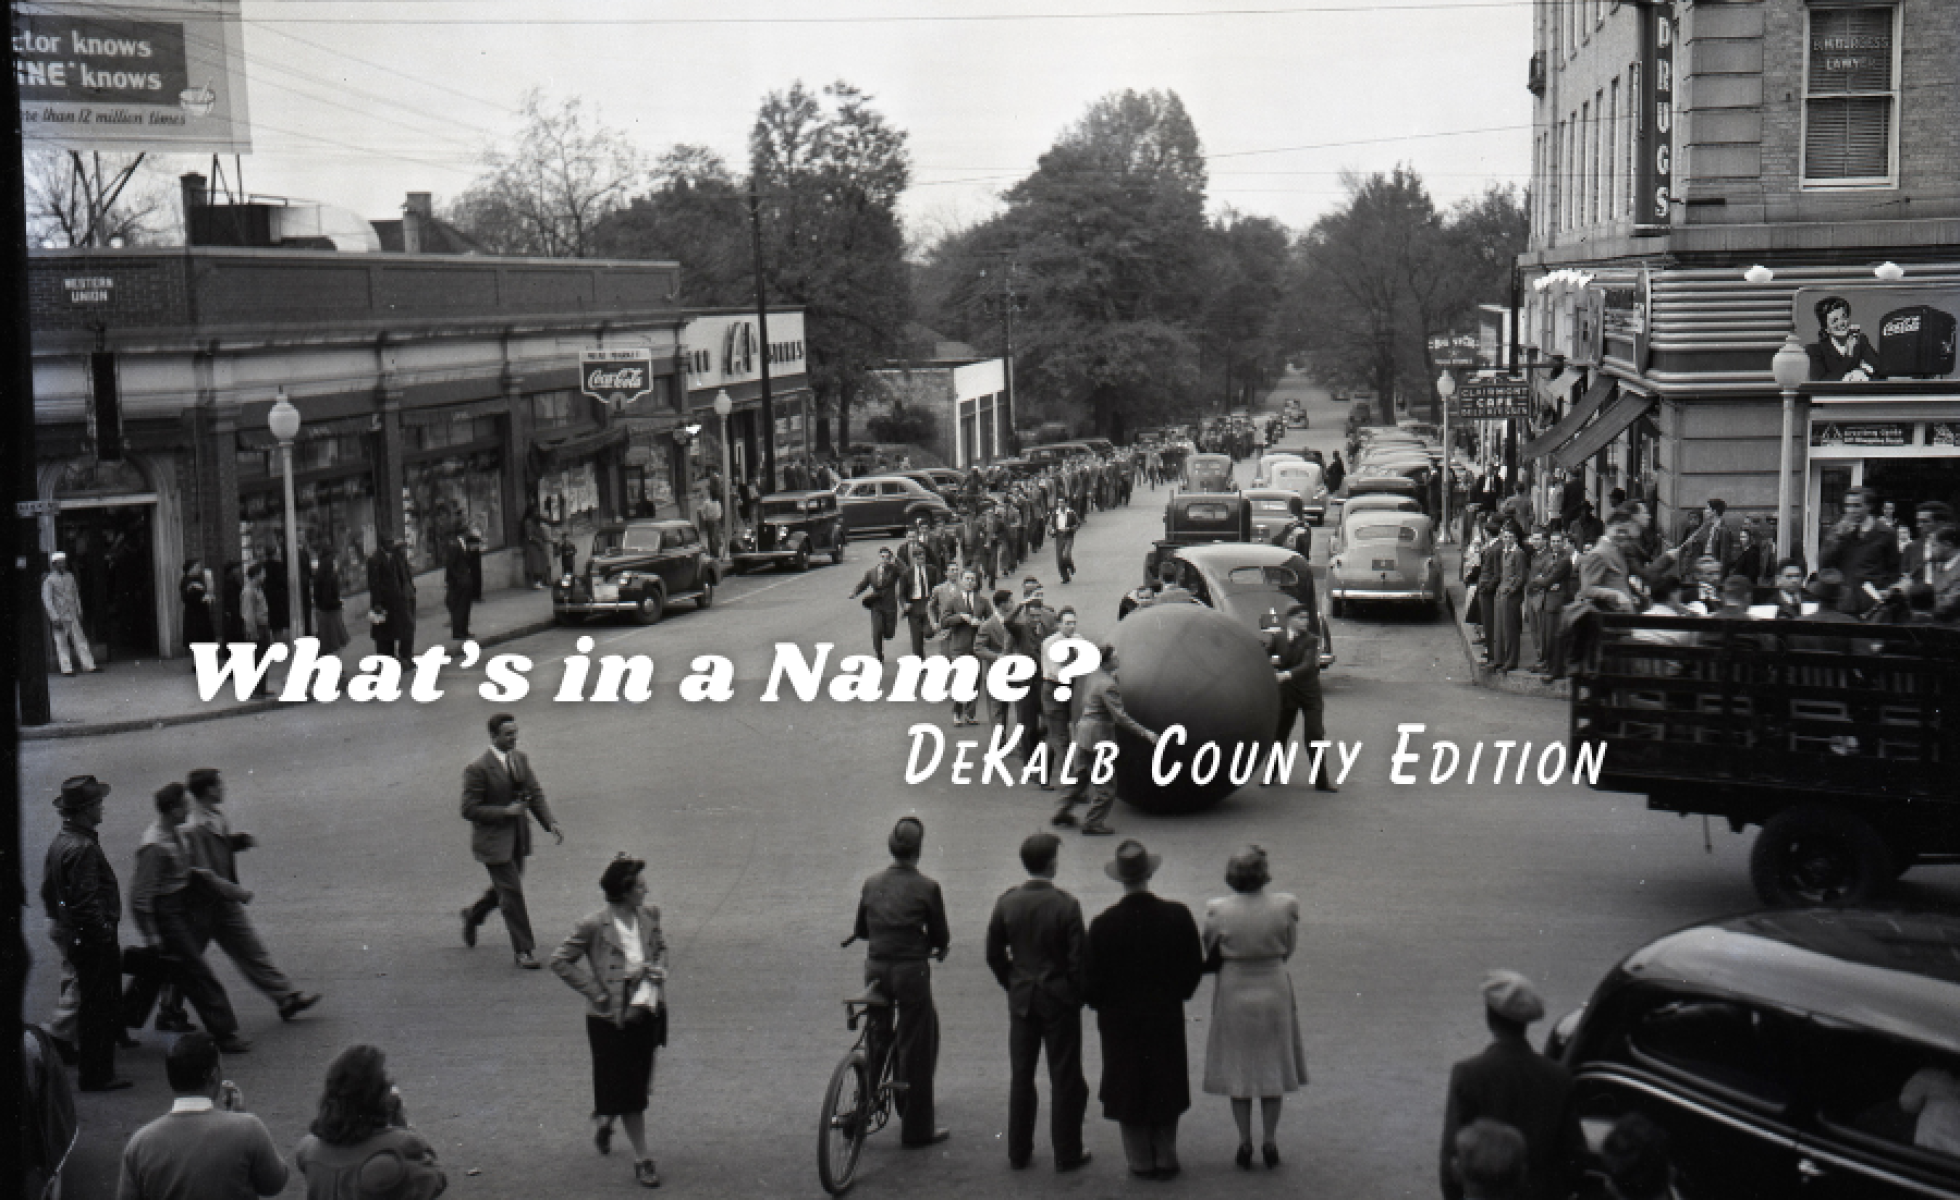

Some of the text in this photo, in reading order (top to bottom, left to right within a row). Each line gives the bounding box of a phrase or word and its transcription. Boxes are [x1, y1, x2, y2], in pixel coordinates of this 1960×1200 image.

[72, 29, 152, 57] knows
[80, 61, 162, 90] knows
[43, 105, 76, 123] than
[78, 107, 93, 124] 12
[96, 107, 144, 124] million
[148, 109, 186, 127] times
[1655, 16, 1670, 218] DRUGS
[71, 290, 108, 303] UNION
[587, 367, 644, 389] Coca-Cola
